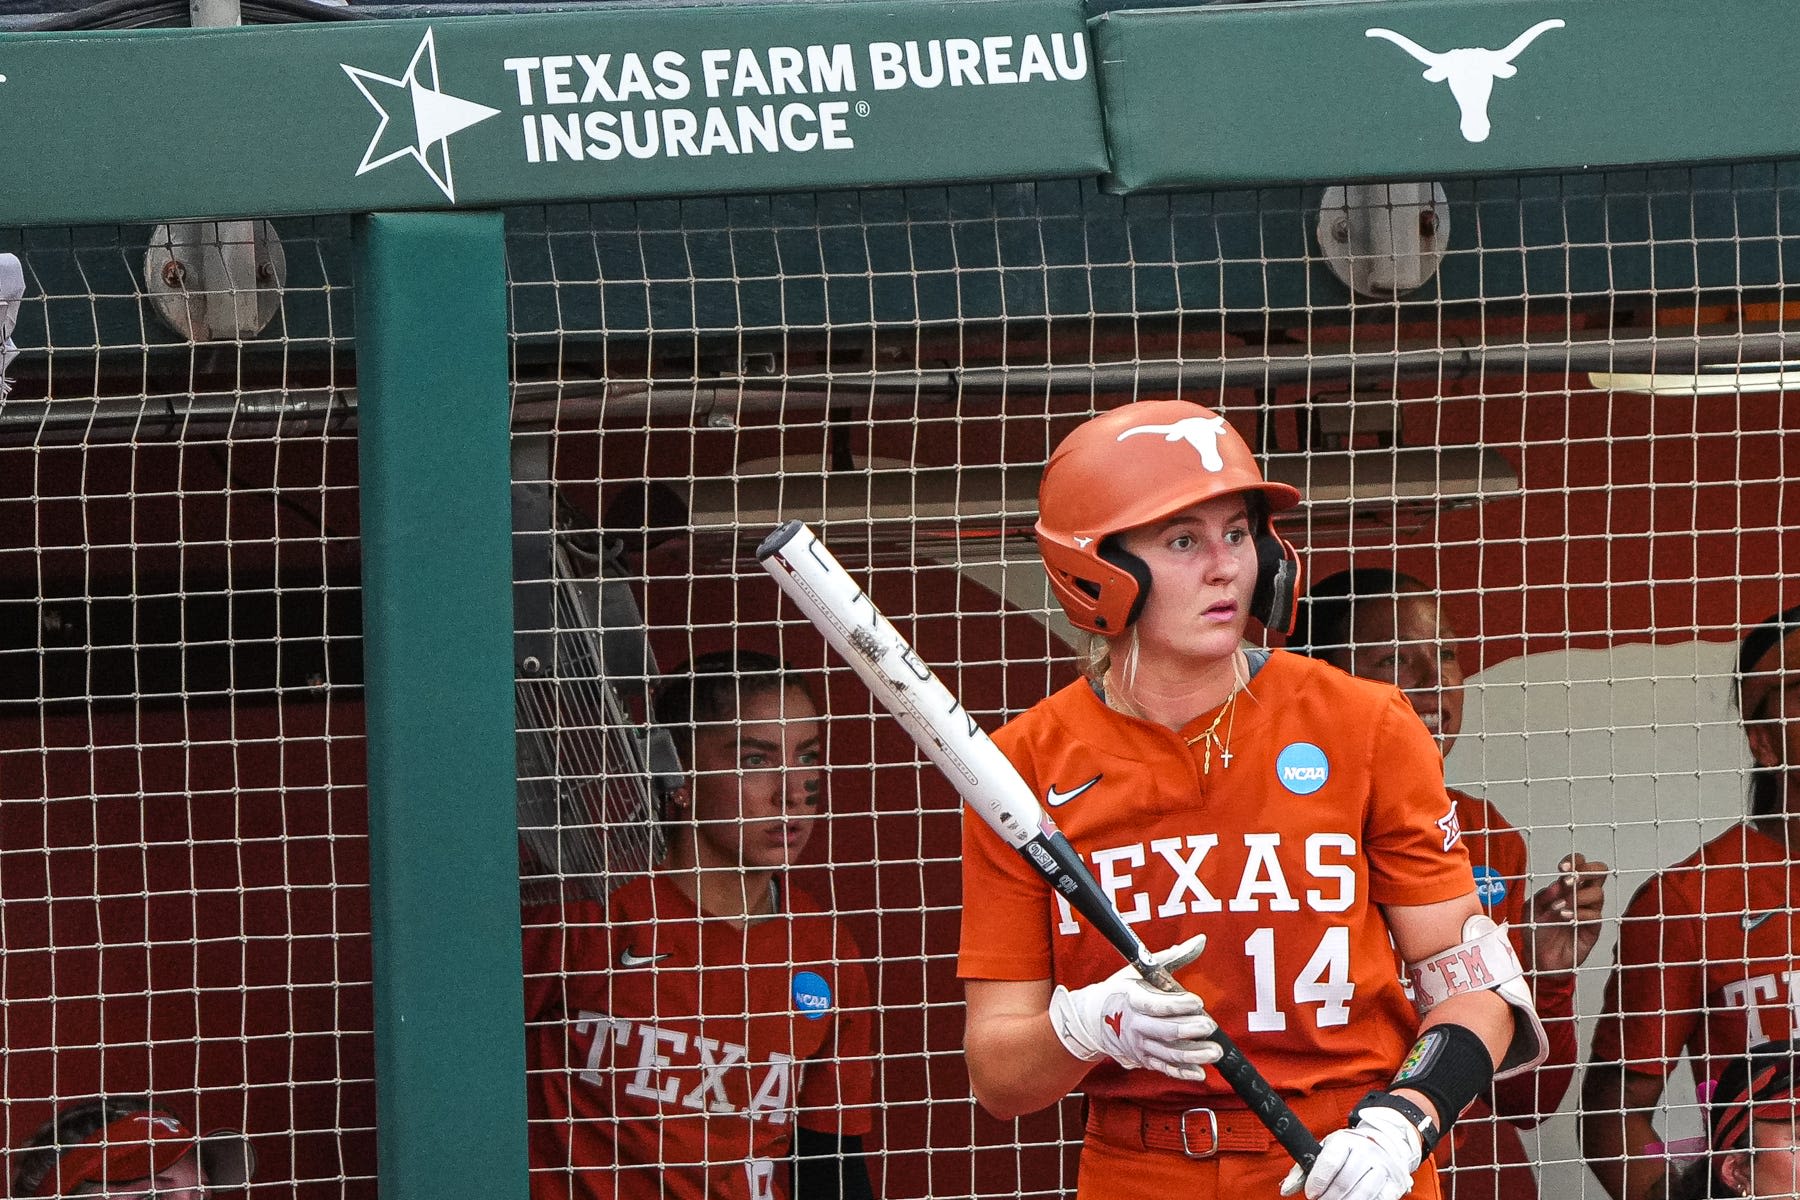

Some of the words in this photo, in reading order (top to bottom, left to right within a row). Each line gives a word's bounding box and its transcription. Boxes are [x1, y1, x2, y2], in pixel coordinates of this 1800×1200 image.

[504, 50, 691, 106] TEXAS
[701, 43, 857, 98] FARM
[869, 31, 1087, 91] BUREAU
[1283, 766, 1326, 781] NCAA
[1475, 879, 1506, 896] CAA
[795, 993, 829, 1010] NCAA
[1244, 926, 1355, 1032] 14
[575, 1009, 804, 1125] TEXA
